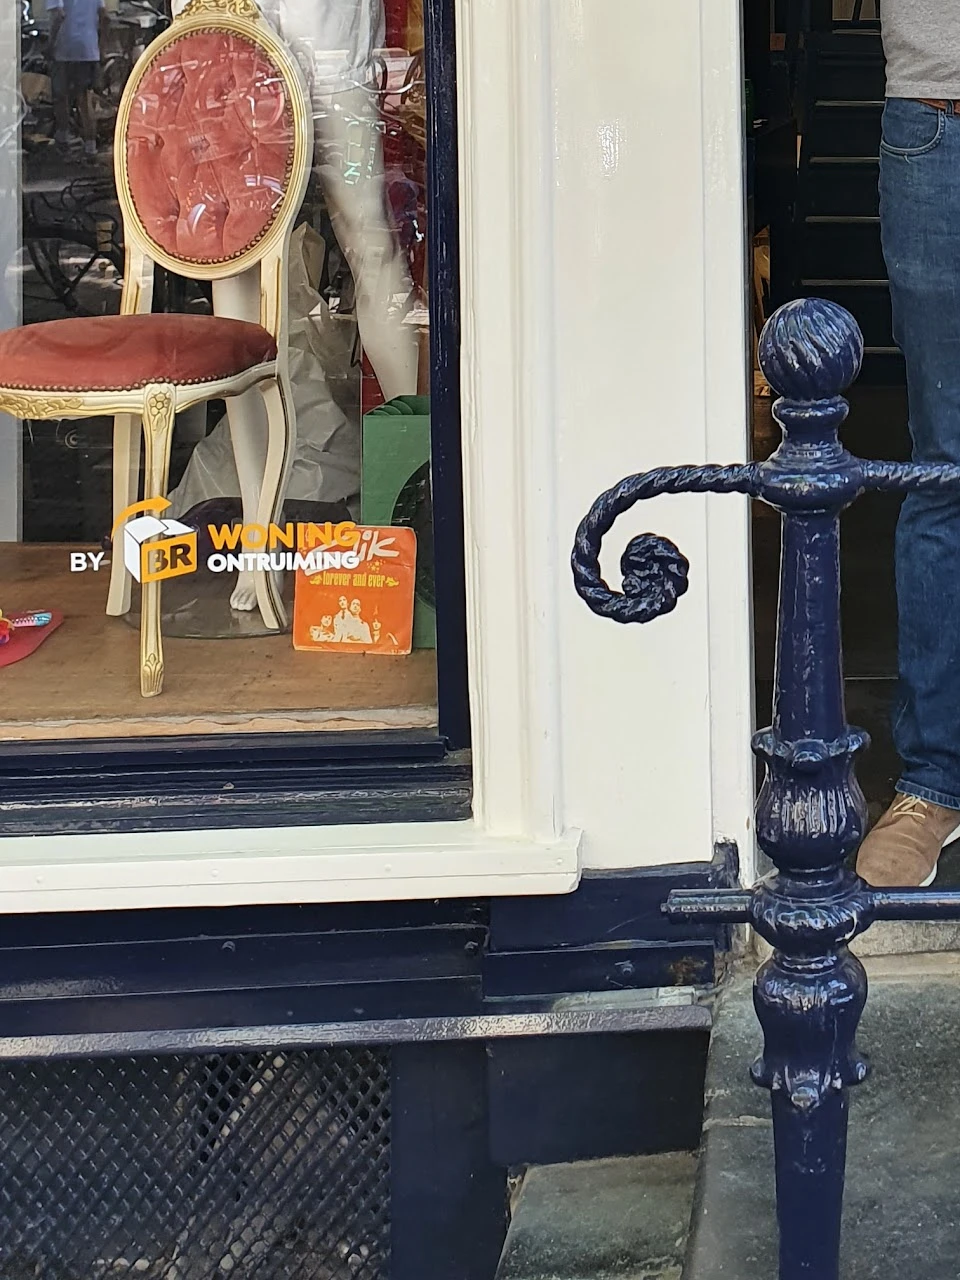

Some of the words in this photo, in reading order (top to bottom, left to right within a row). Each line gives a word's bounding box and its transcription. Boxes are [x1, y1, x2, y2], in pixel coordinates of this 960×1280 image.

[207, 521, 361, 551] WONING
[70, 552, 105, 572] BY
[148, 544, 192, 575] BR
[207, 551, 360, 572] ONTRUIMING
[322, 570, 351, 587] forever
[352, 571, 367, 587] and
[367, 573, 385, 588] ever
